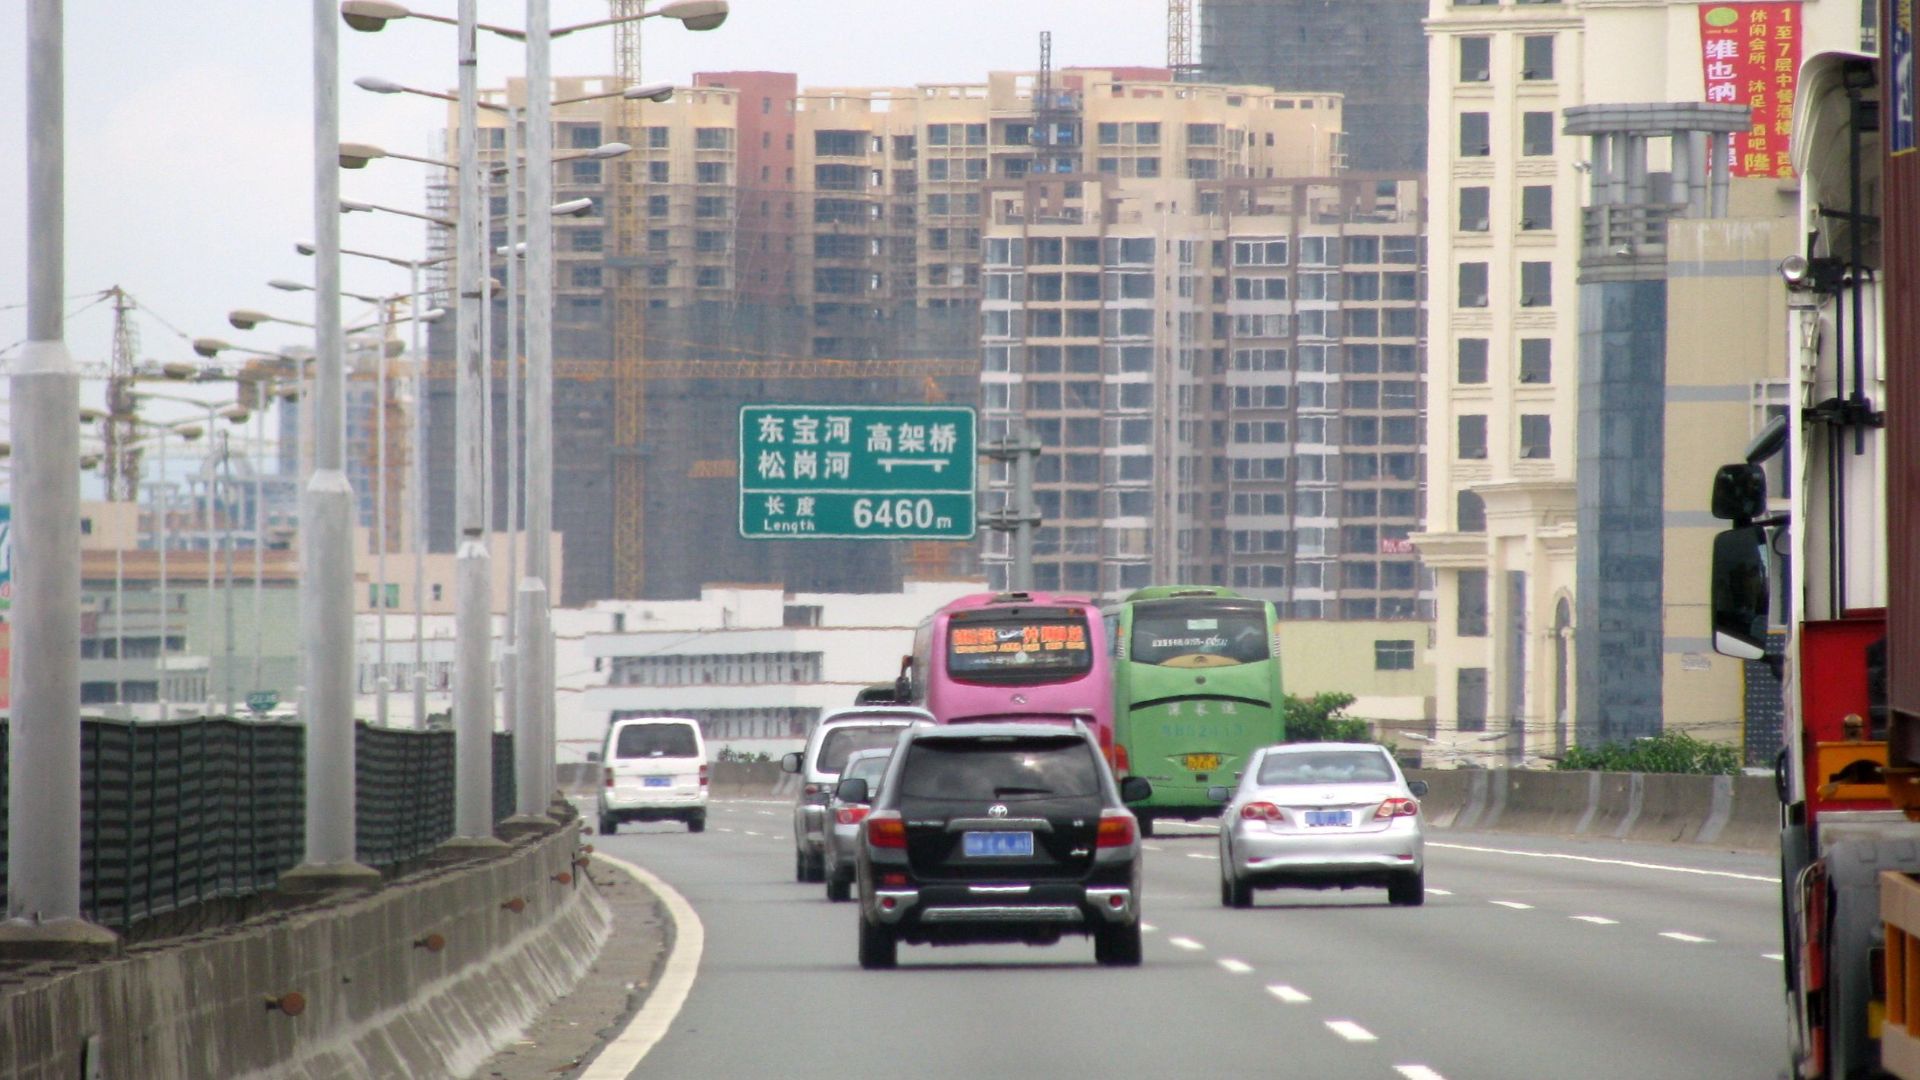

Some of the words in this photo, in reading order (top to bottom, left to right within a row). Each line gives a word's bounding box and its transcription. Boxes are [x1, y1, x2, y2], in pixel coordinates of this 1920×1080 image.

[1706, 39, 1739, 102] 维也纳
[758, 415, 852, 444] 东宝河
[866, 423, 957, 454] 高架桥
[758, 451, 851, 479] 松岗河
[765, 496, 815, 517] 长度
[764, 519, 815, 534] Length
